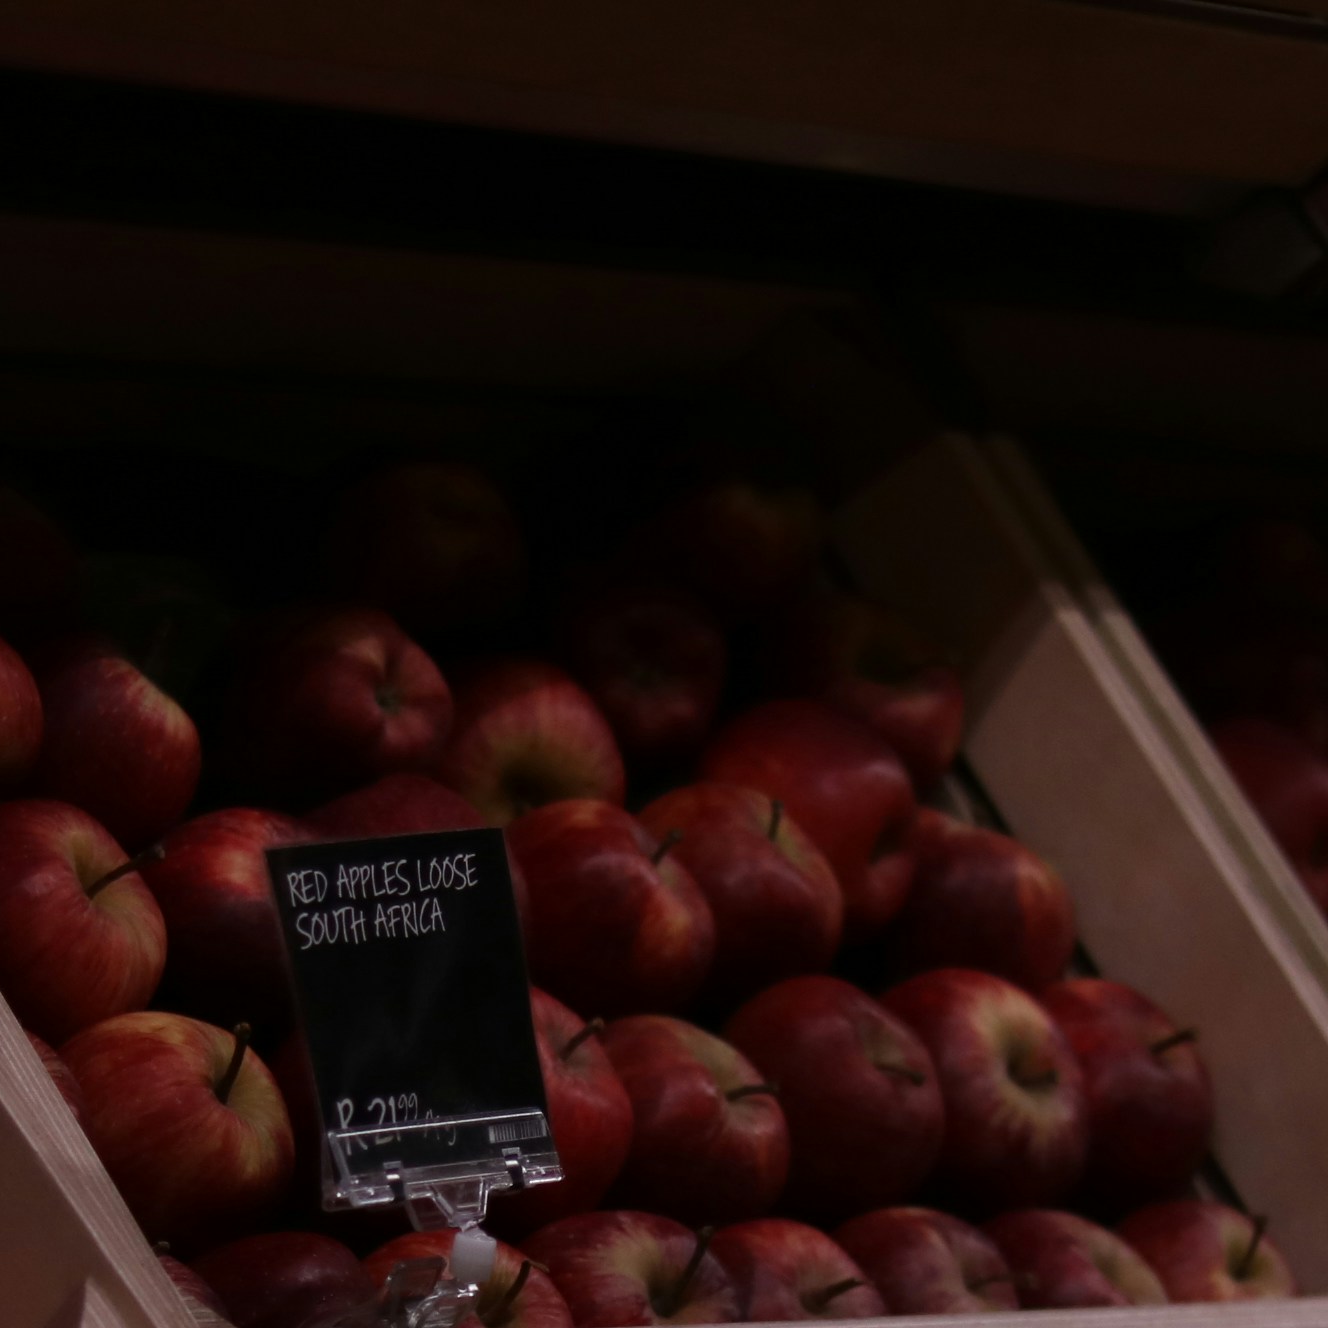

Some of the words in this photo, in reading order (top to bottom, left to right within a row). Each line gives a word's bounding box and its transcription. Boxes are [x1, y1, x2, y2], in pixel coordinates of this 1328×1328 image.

[286, 869, 328, 908] RED
[336, 858, 411, 900] APPLES
[416, 853, 480, 892] LOOSE
[295, 906, 367, 950] SOUTH
[374, 897, 446, 939] AFRICA
[336, 1098, 368, 1156] R
